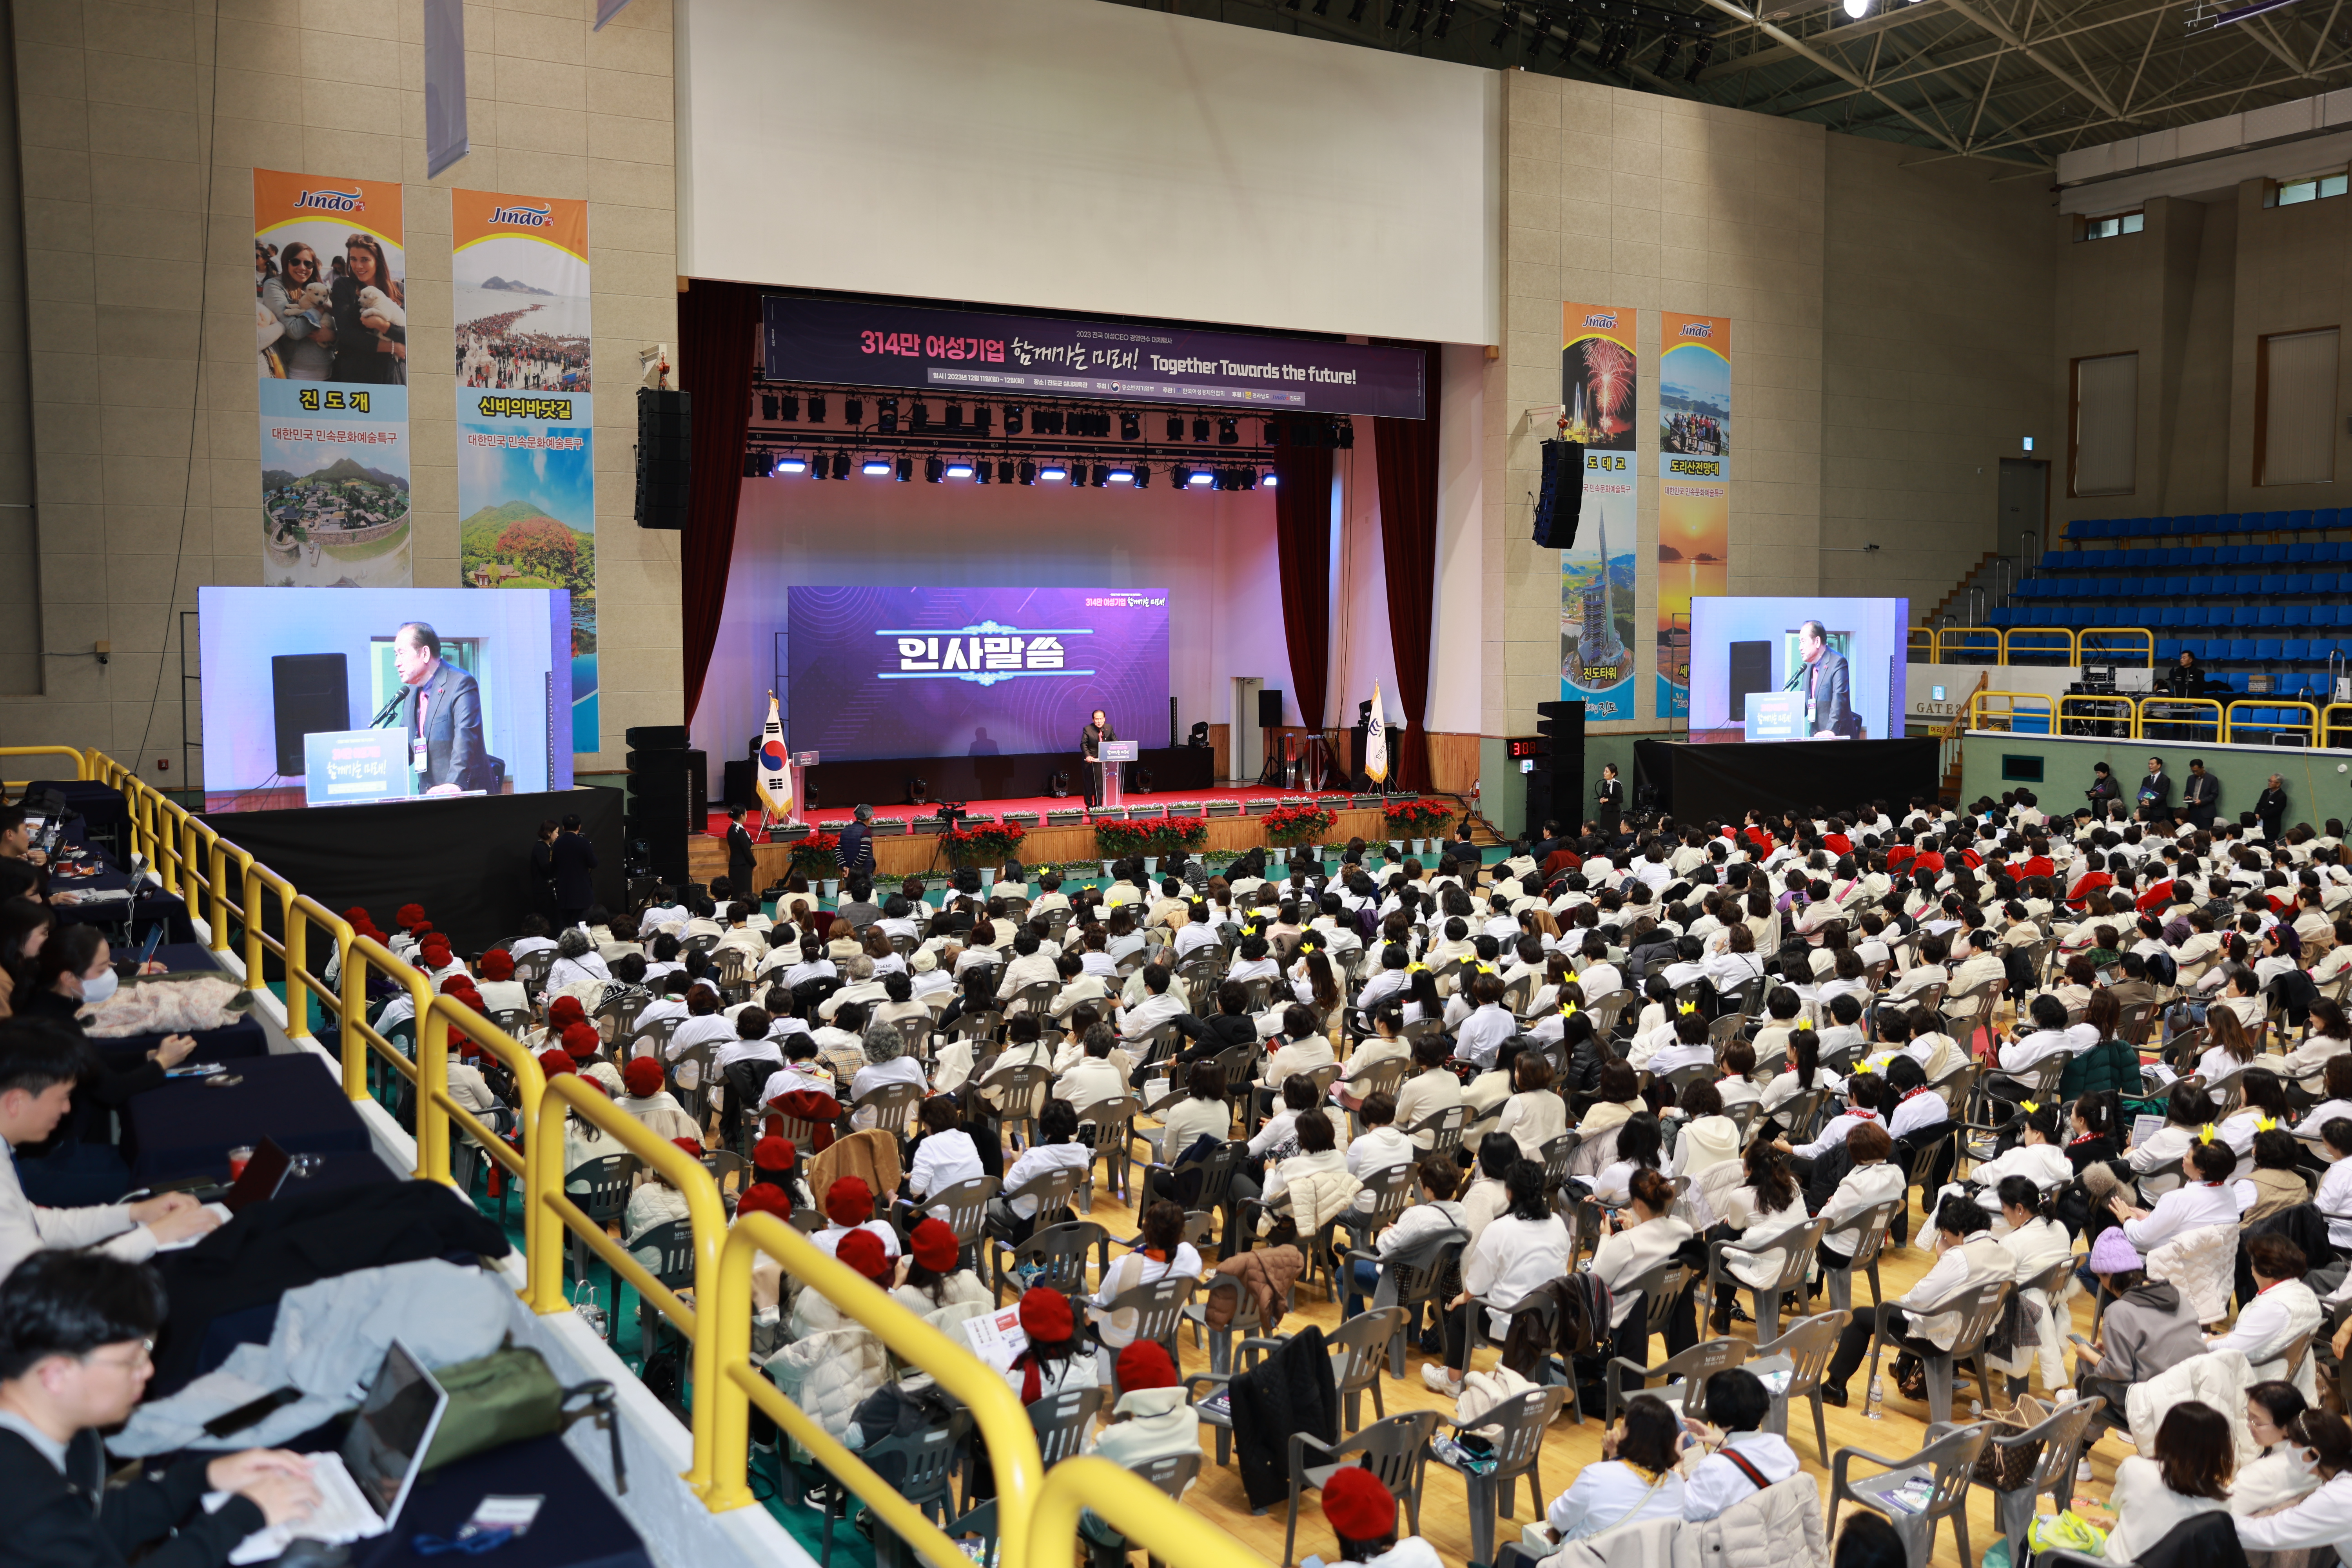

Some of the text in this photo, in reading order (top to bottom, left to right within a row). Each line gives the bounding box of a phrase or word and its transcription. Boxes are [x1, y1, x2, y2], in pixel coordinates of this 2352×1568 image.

[294, 191, 355, 212] Jindo
[488, 207, 544, 227] Jindo
[1582, 315, 1612, 329] Jindo
[1130, 334, 1151, 343] 경영연수
[1679, 324, 1708, 338] Jindo
[861, 330, 1139, 370] 314만 여성기업 함께가는 미래!
[1151, 355, 1356, 385] Together Towards the future!
[1122, 384, 1154, 392] 중소벤처기업부
[1182, 389, 1225, 397] 한국여성경제인협회
[478, 396, 572, 420] 신비의바닷길
[272, 427, 398, 445] 대한민국 민속문화예술특구
[468, 434, 584, 450] 대한민국 민속문화예술특구
[1587, 456, 1626, 472] 도대교
[1670, 459, 1719, 476] 도리산전망대
[1590, 484, 1631, 494] 민속문화예술특구
[1664, 486, 1724, 497] 대한민국 민속문화예술특구
[1085, 597, 1165, 607] 314만 여성기업 함께가는 미래!
[898, 637, 1064, 670] 인사말씀
[1583, 665, 1618, 681] 진도타워
[1679, 664, 1690, 678] 세
[1599, 701, 1618, 717] 진도
[327, 759, 387, 780] 함께가는 미래!
[1524, 1402, 1544, 1412] 남도기획
